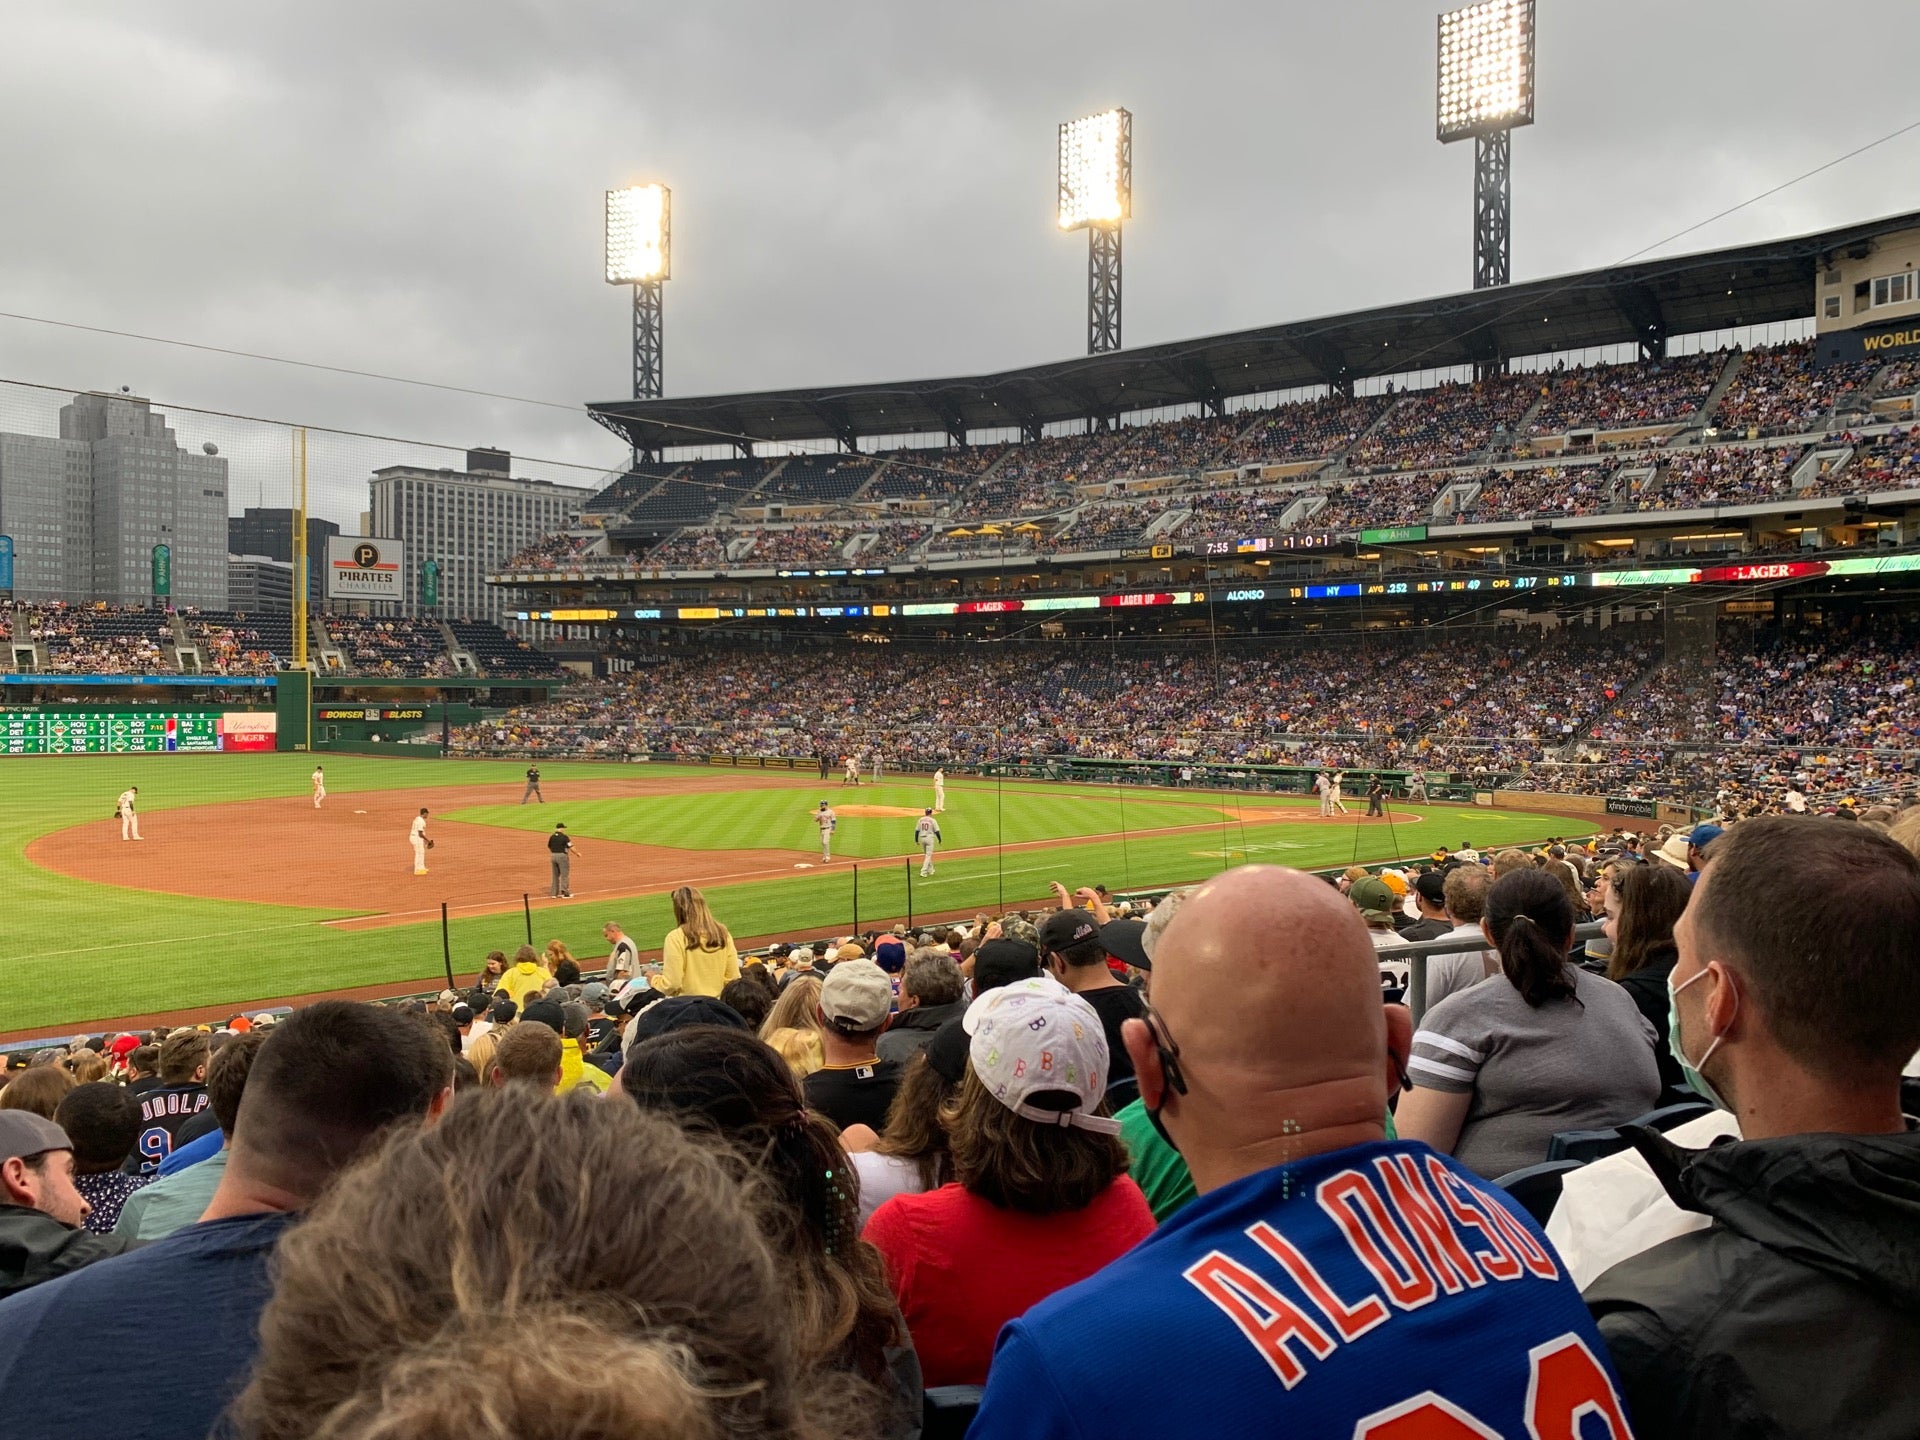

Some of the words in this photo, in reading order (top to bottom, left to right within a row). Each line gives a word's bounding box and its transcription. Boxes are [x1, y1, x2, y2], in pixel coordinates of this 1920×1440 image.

[1863, 330, 1920, 351] WORLD
[1289, 537, 1294, 548] 1
[1305, 536, 1313, 547] 0
[1323, 535, 1328, 546] 1
[1207, 543, 1228, 554] 7:55
[361, 548, 373, 564] P
[340, 572, 392, 582] PIRATES
[1738, 564, 1788, 579] LAGER
[340, 582, 392, 590] CHARITIES
[1194, 592, 1204, 602] 20
[1226, 590, 1264, 600] ALONSO
[1290, 588, 1302, 598] 1B
[1326, 586, 1340, 596] NY
[1387, 584, 1408, 593] .252
[1418, 584, 1428, 592] HR
[1432, 582, 1444, 591] 17
[1468, 580, 1480, 590] 49
[1492, 580, 1510, 588] OPS
[1515, 577, 1538, 588] .817
[1563, 576, 1576, 586] 31
[1120, 594, 1138, 606] LAGER
[1142, 594, 1155, 605] UP
[767, 608, 776, 616] 19
[890, 606, 896, 614] 4
[976, 602, 1004, 612] LAGER
[326, 710, 364, 718] BOWSER
[366, 710, 378, 718] 35
[389, 710, 422, 718] BLASTS
[1608, 801, 1628, 812] xfinity
[1629, 804, 1652, 814] mobile
[922, 822, 928, 831] 10
[1041, 1051, 1053, 1071] B
[1014, 1058, 1026, 1078] B
[140, 1126, 172, 1174] 9
[1182, 1153, 1559, 1391] ALONSO
